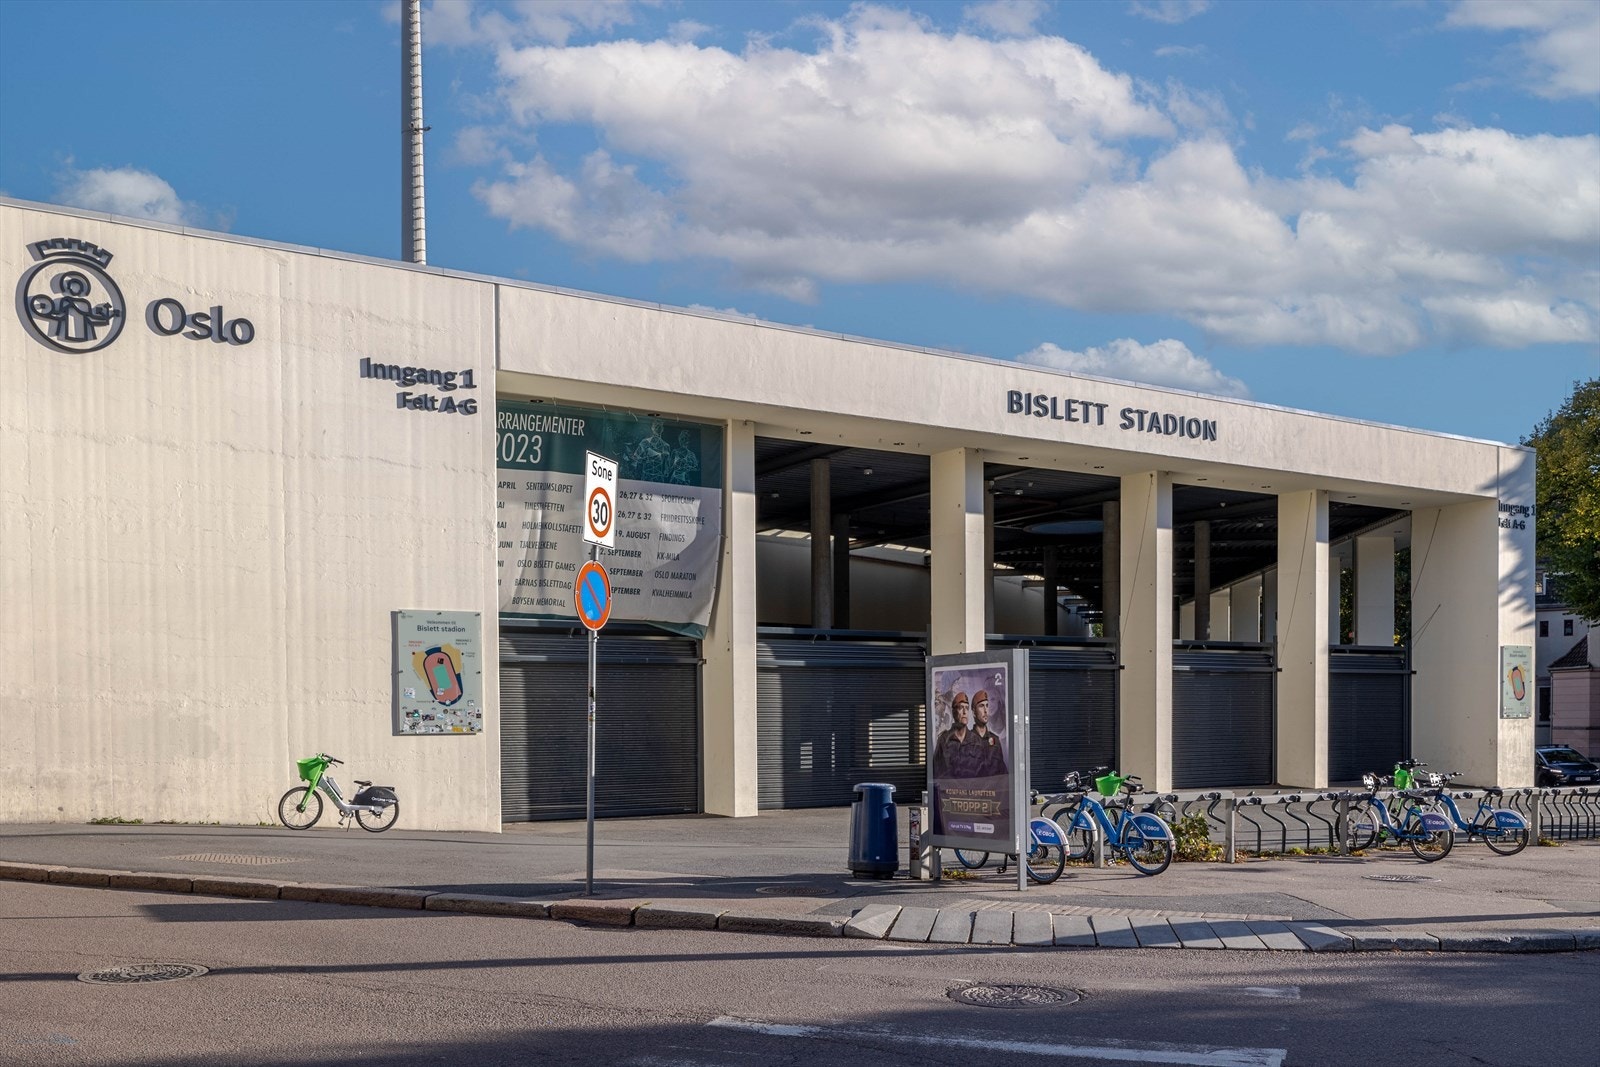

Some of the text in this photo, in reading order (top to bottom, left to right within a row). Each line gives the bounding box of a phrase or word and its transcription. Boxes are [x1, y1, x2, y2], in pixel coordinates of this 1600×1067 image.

[145, 298, 255, 346] Oslo
[360, 357, 477, 392] Inngang 1
[396, 391, 477, 416] Felt A-G
[1007, 390, 1217, 442] BISLETT STADION
[496, 411, 585, 436] RRANGEMENTER
[591, 460, 613, 482] Sone
[498, 481, 573, 494] APRIL SENTRUMSLØPET
[619, 490, 638, 500] 26,27
[639, 492, 644, 500] &
[645, 493, 653, 501] 32
[497, 501, 505, 509] AI
[592, 499, 608, 526] 30
[617, 510, 635, 520] 26,27
[637, 512, 642, 520] &
[643, 512, 652, 521] 32
[626, 531, 651, 540] AUGUST
[498, 541, 513, 549] JUNI
[608, 549, 642, 559] SEPTEMBER
[517, 559, 532, 568] OSLO
[533, 560, 553, 569] BISLETT
[555, 562, 576, 572] GAMES
[609, 568, 697, 581] SEPTEMBER OSLO MARATON
[515, 578, 537, 587] BARNAS
[611, 587, 641, 596] EPTEMBER
[536, 597, 566, 608] MEMORIAL
[441, 625, 466, 633] stadion
[994, 672, 1002, 686] 2
[952, 800, 988, 813] TROPP 2
